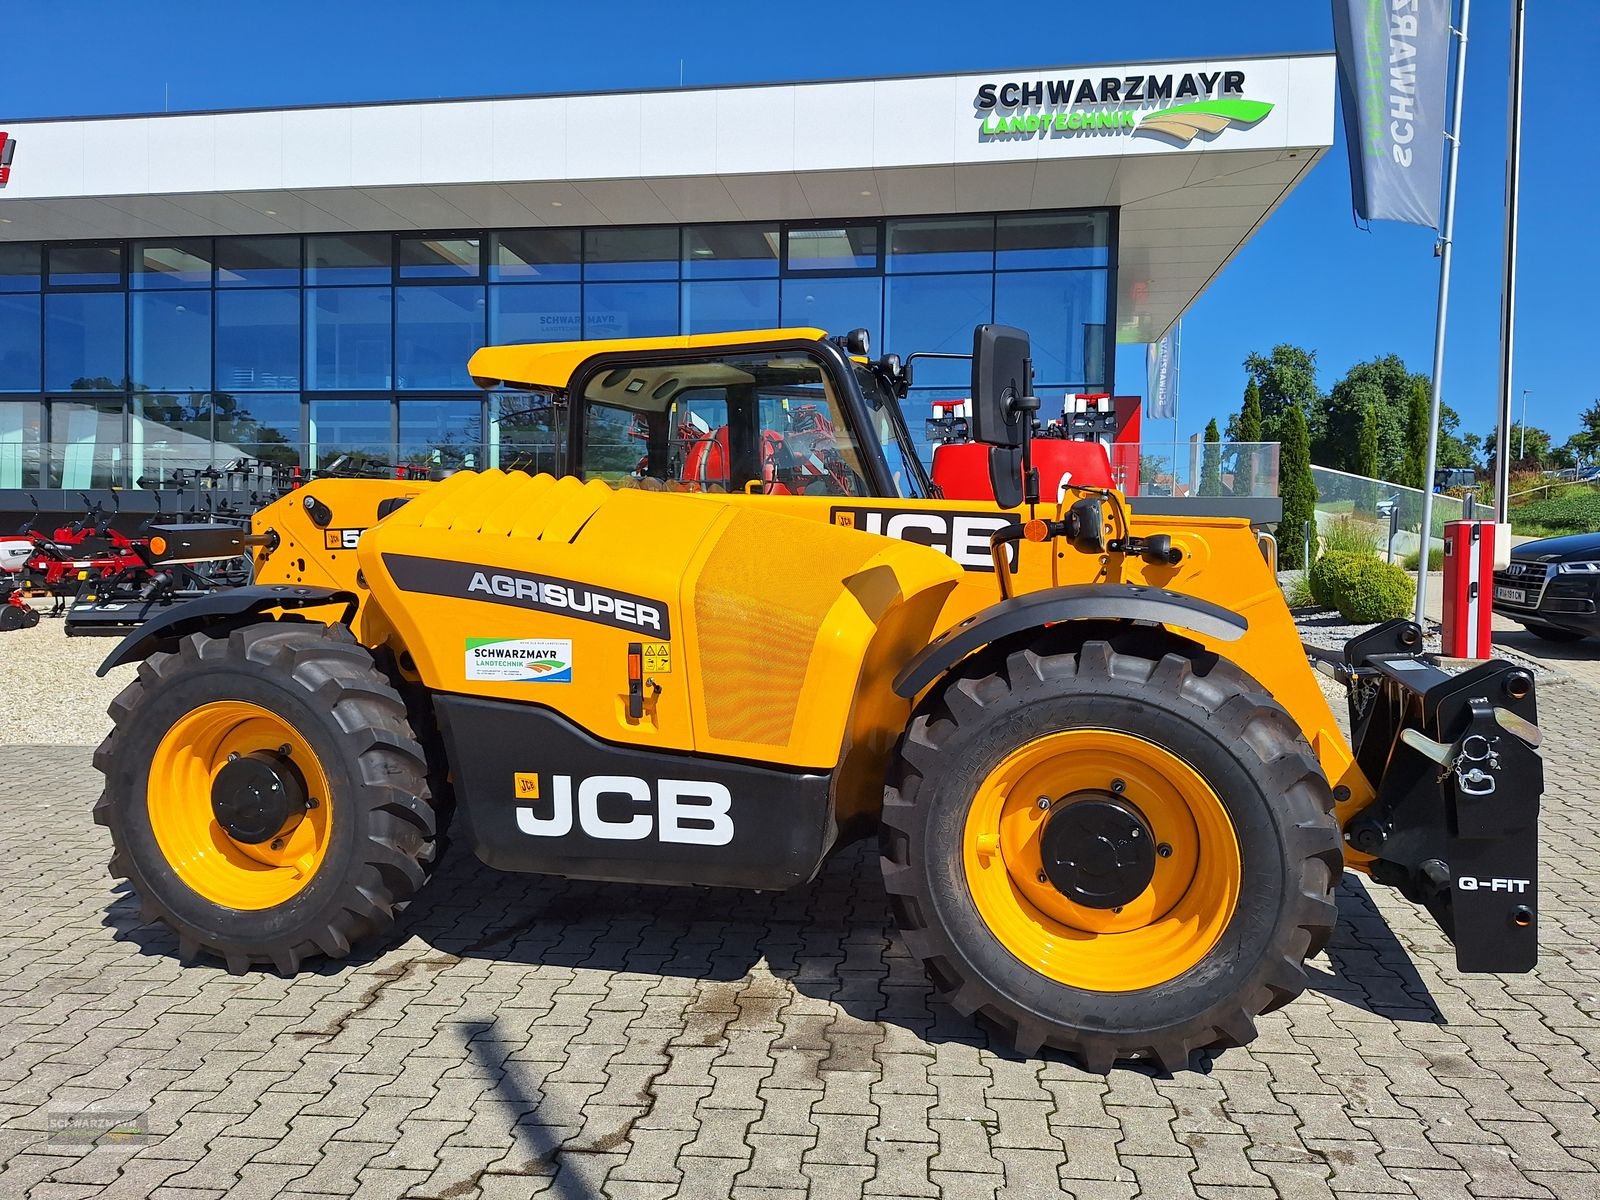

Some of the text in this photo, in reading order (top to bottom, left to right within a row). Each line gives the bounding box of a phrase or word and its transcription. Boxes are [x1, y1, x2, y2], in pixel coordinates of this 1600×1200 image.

[977, 71, 1246, 109] SCHWARZMAYR
[982, 110, 1137, 135] LANDTECHNIK
[540, 316, 615, 325] SCHWARMAYR
[467, 571, 661, 630] AGRISUPER
[474, 648, 557, 659] SCHWARZMAYR
[520, 779, 535, 792] JCB
[515, 774, 735, 846] JCB
[1458, 876, 1531, 893] Q-FIT
